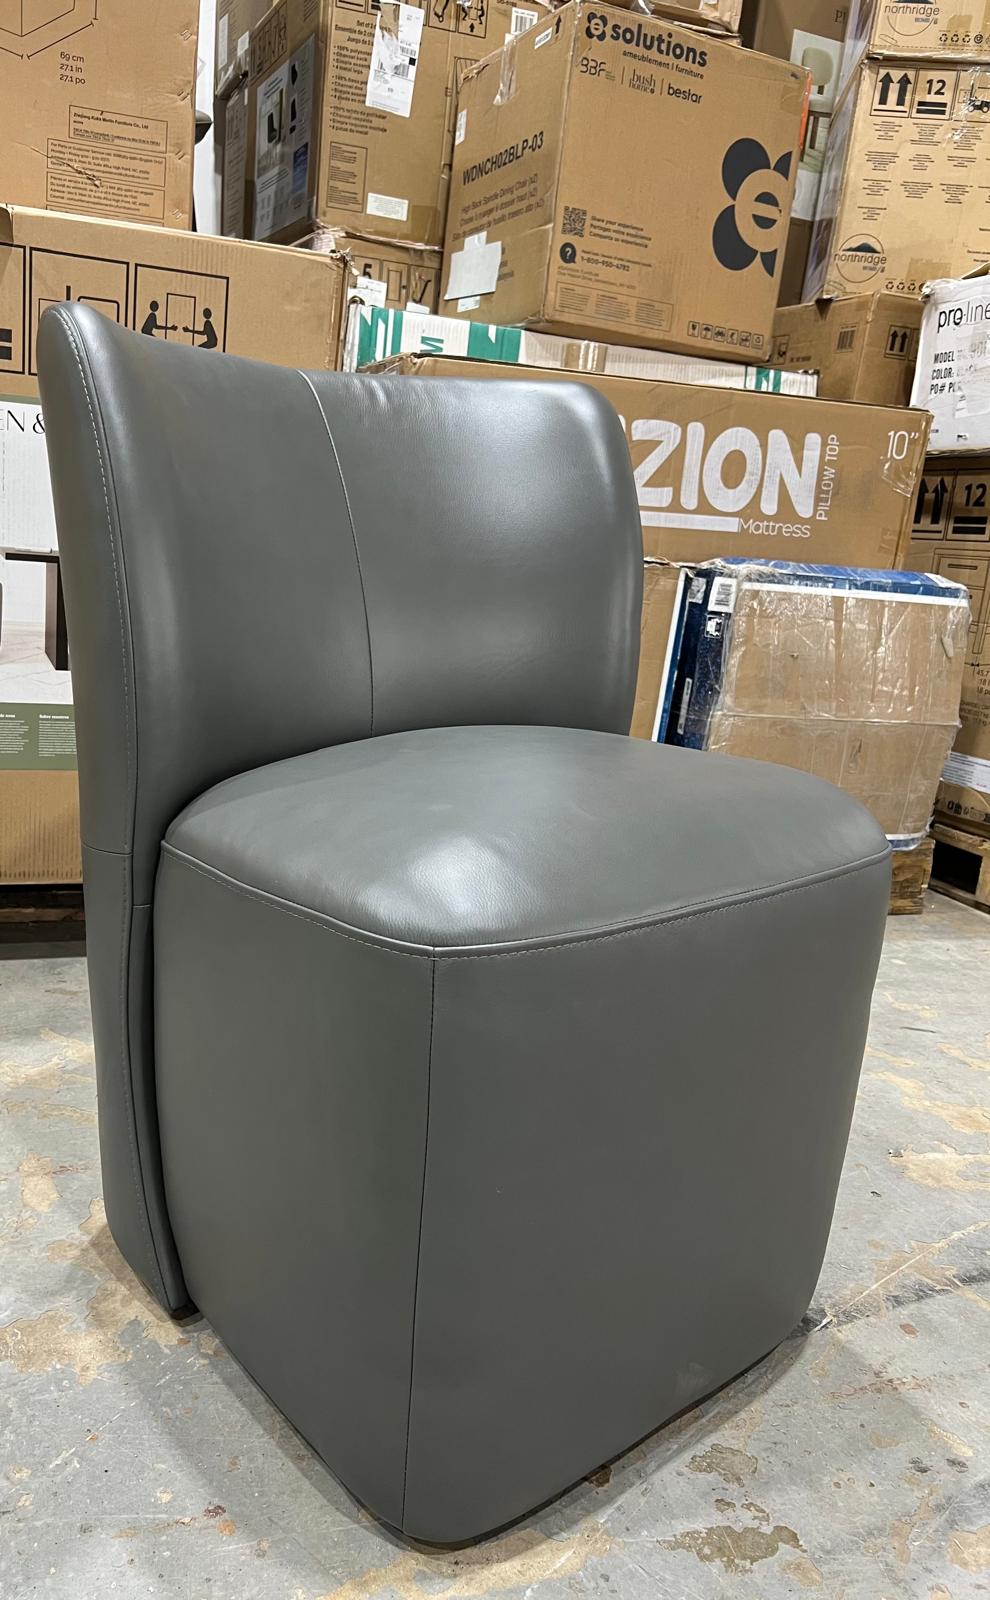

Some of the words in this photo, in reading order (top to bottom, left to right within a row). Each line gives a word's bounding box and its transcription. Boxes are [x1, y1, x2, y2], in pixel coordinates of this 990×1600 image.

[884, 4, 940, 18] northridge
[610, 24, 708, 68] solutions
[60, 51, 71, 62] 69
[72, 54, 85, 63] cm
[622, 50, 670, 70] ameublement
[675, 64, 704, 80] furniture
[60, 63, 74, 72] 27.1
[75, 64, 82, 73] in
[631, 68, 656, 88] bush
[60, 74, 74, 83] 27.1
[75, 76, 86, 85] po
[926, 78, 947, 96] 12
[667, 82, 702, 104] bestar
[462, 130, 544, 186] WDNCH02BLP-03
[834, 253, 887, 266] northridge
[933, 350, 955, 364] MODEL
[930, 382, 946, 394] PO#
[826, 434, 840, 460] TOP
[817, 464, 837, 520] PILLOW
[964, 483, 988, 507] 12
[739, 518, 811, 538] Mattress
